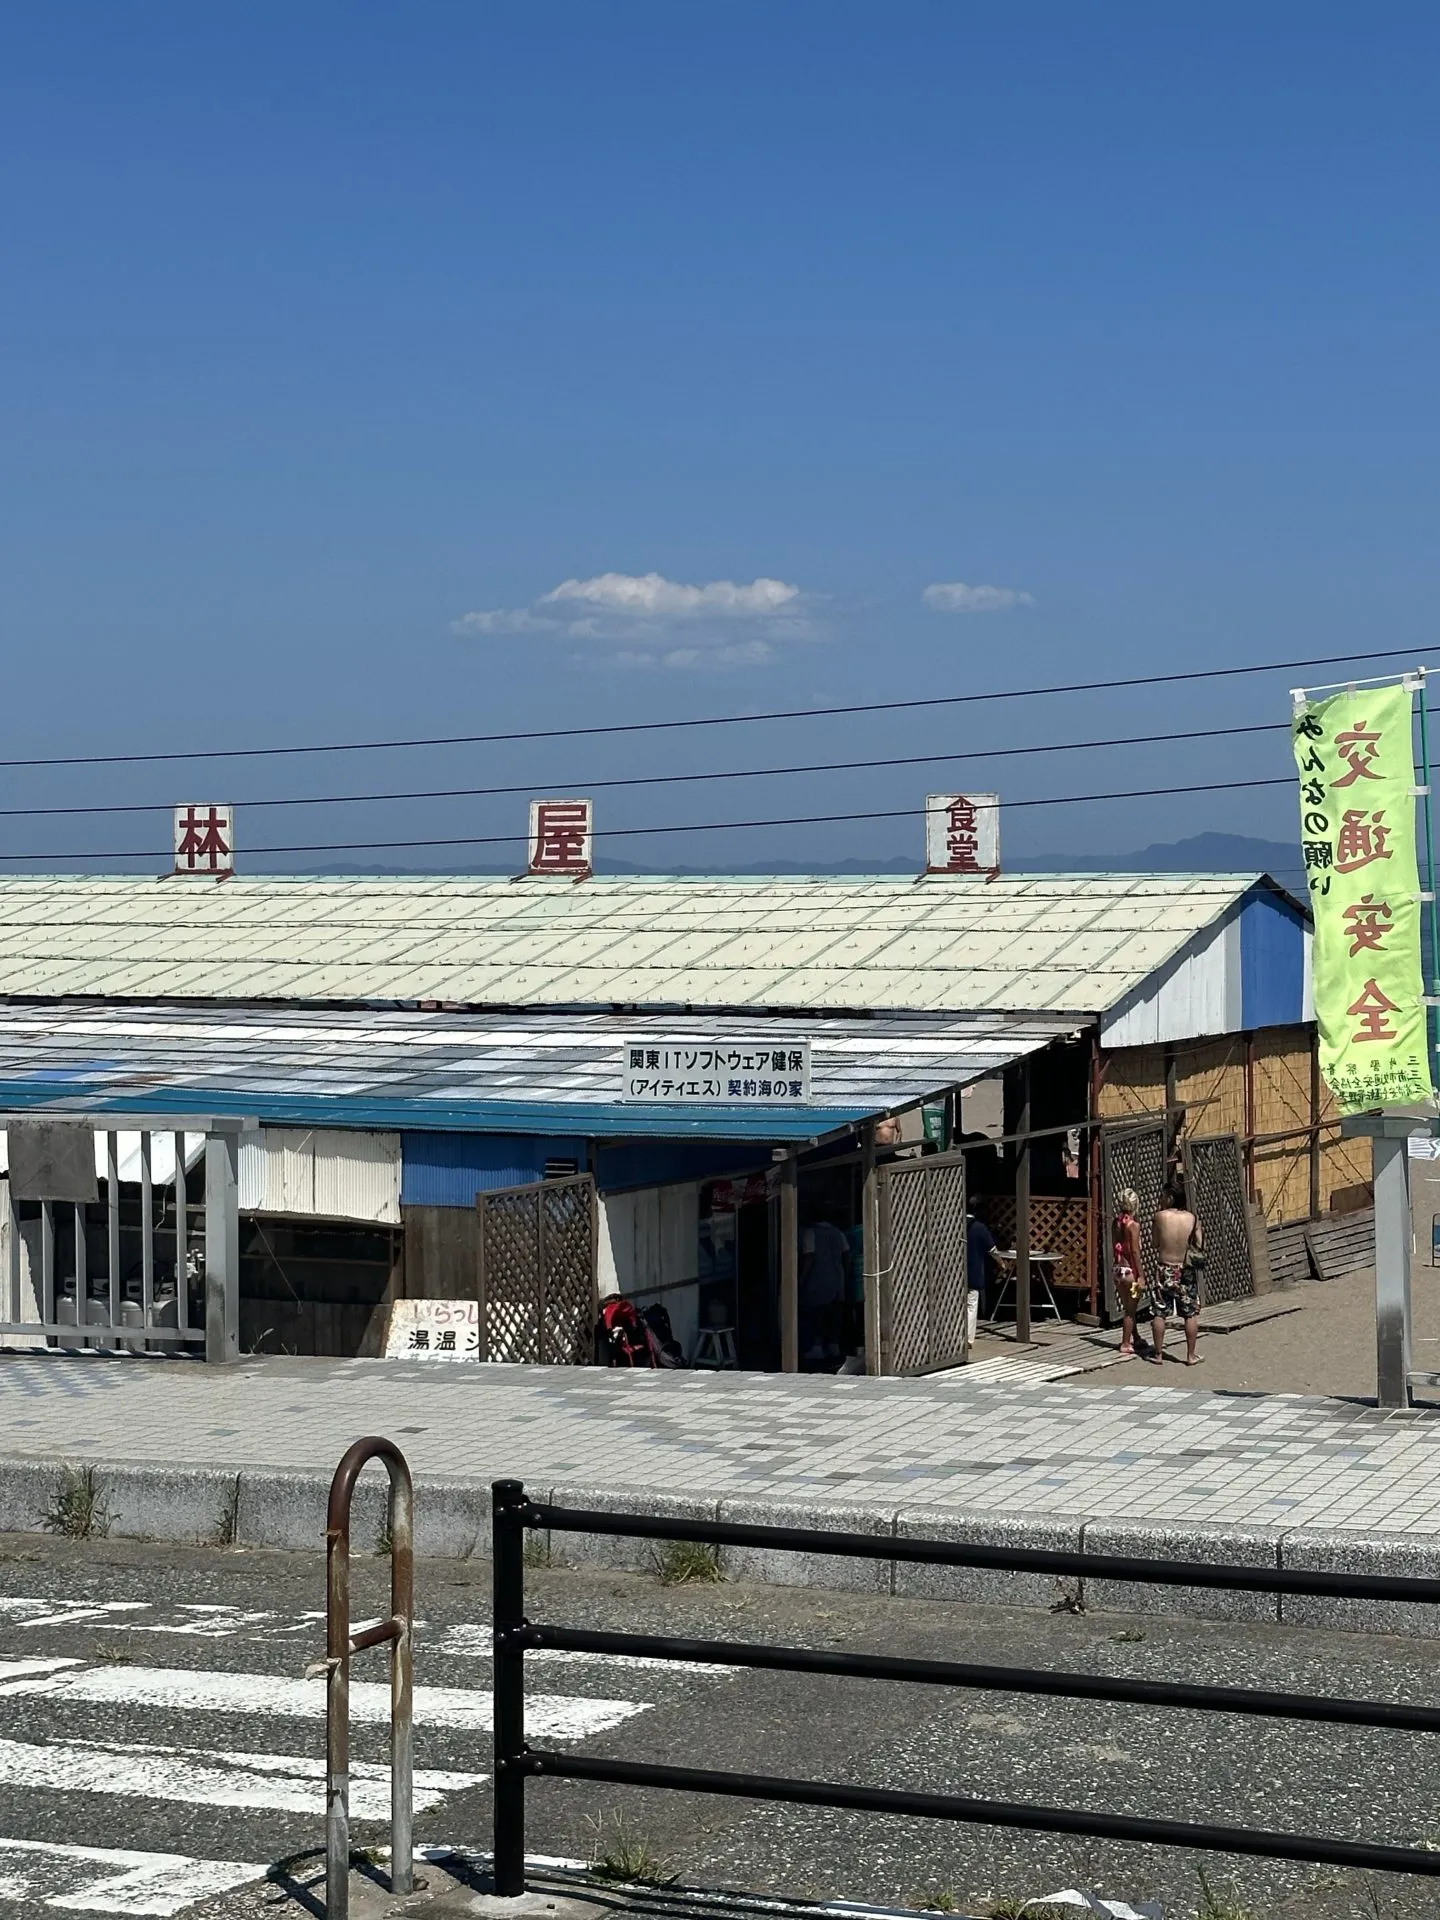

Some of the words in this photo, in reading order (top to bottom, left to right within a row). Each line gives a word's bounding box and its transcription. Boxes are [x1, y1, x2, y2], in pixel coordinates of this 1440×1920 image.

[178, 808, 229, 868] 林
[532, 805, 588, 867] 屋
[946, 797, 979, 868] 食堂
[630, 1049, 804, 1071] 関東ITソフトウェア健保
[728, 1079, 803, 1098] 契約海の家
